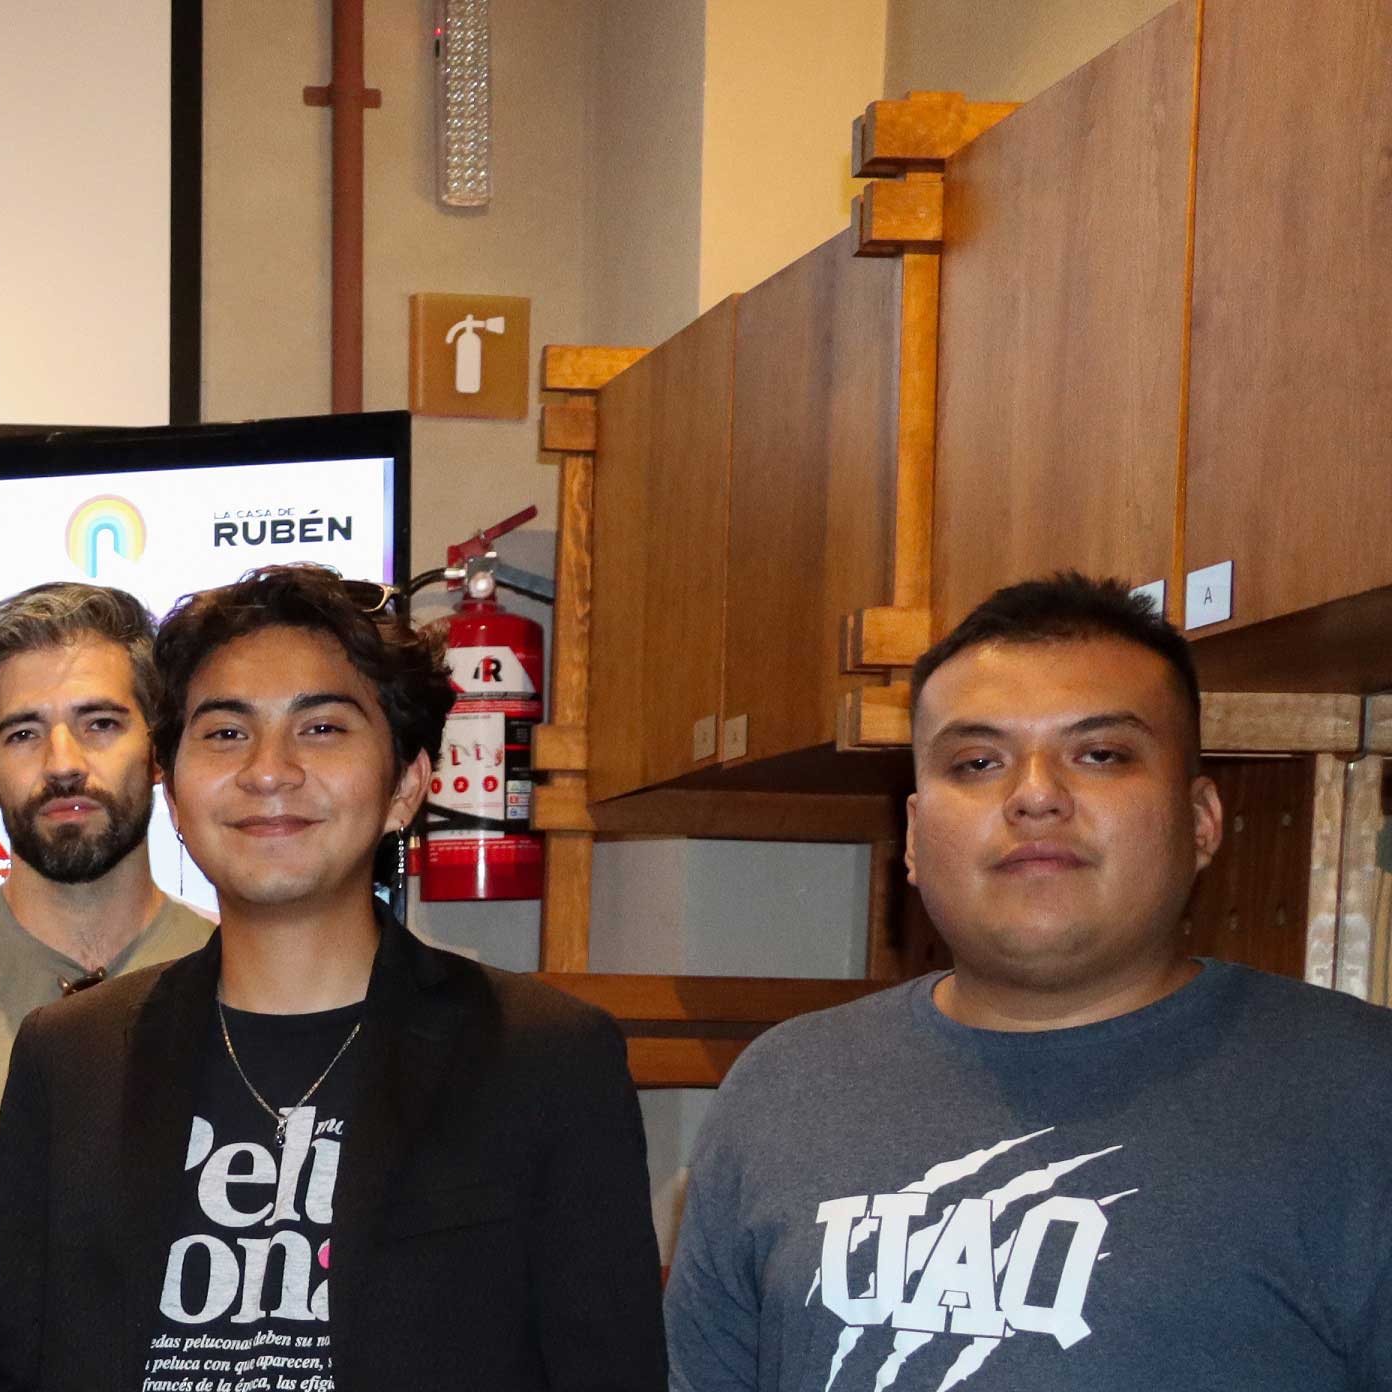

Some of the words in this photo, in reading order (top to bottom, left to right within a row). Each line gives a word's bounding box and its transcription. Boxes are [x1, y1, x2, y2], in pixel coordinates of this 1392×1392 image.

[213, 511, 231, 521] LA
[236, 508, 273, 520] CASA
[277, 506, 295, 517] DE
[214, 508, 353, 548] RUBÉN
[1203, 586, 1213, 605] A
[816, 1192, 1108, 1350] UAQ
[252, 1330, 292, 1348] deben
[295, 1335, 313, 1348] su
[151, 1356, 201, 1374] peluca
[203, 1359, 231, 1372] con
[234, 1358, 255, 1376] que
[255, 1355, 324, 1372] aparecen,
[195, 1377, 214, 1392] de
[216, 1377, 232, 1392] la
[276, 1374, 298, 1391] las
